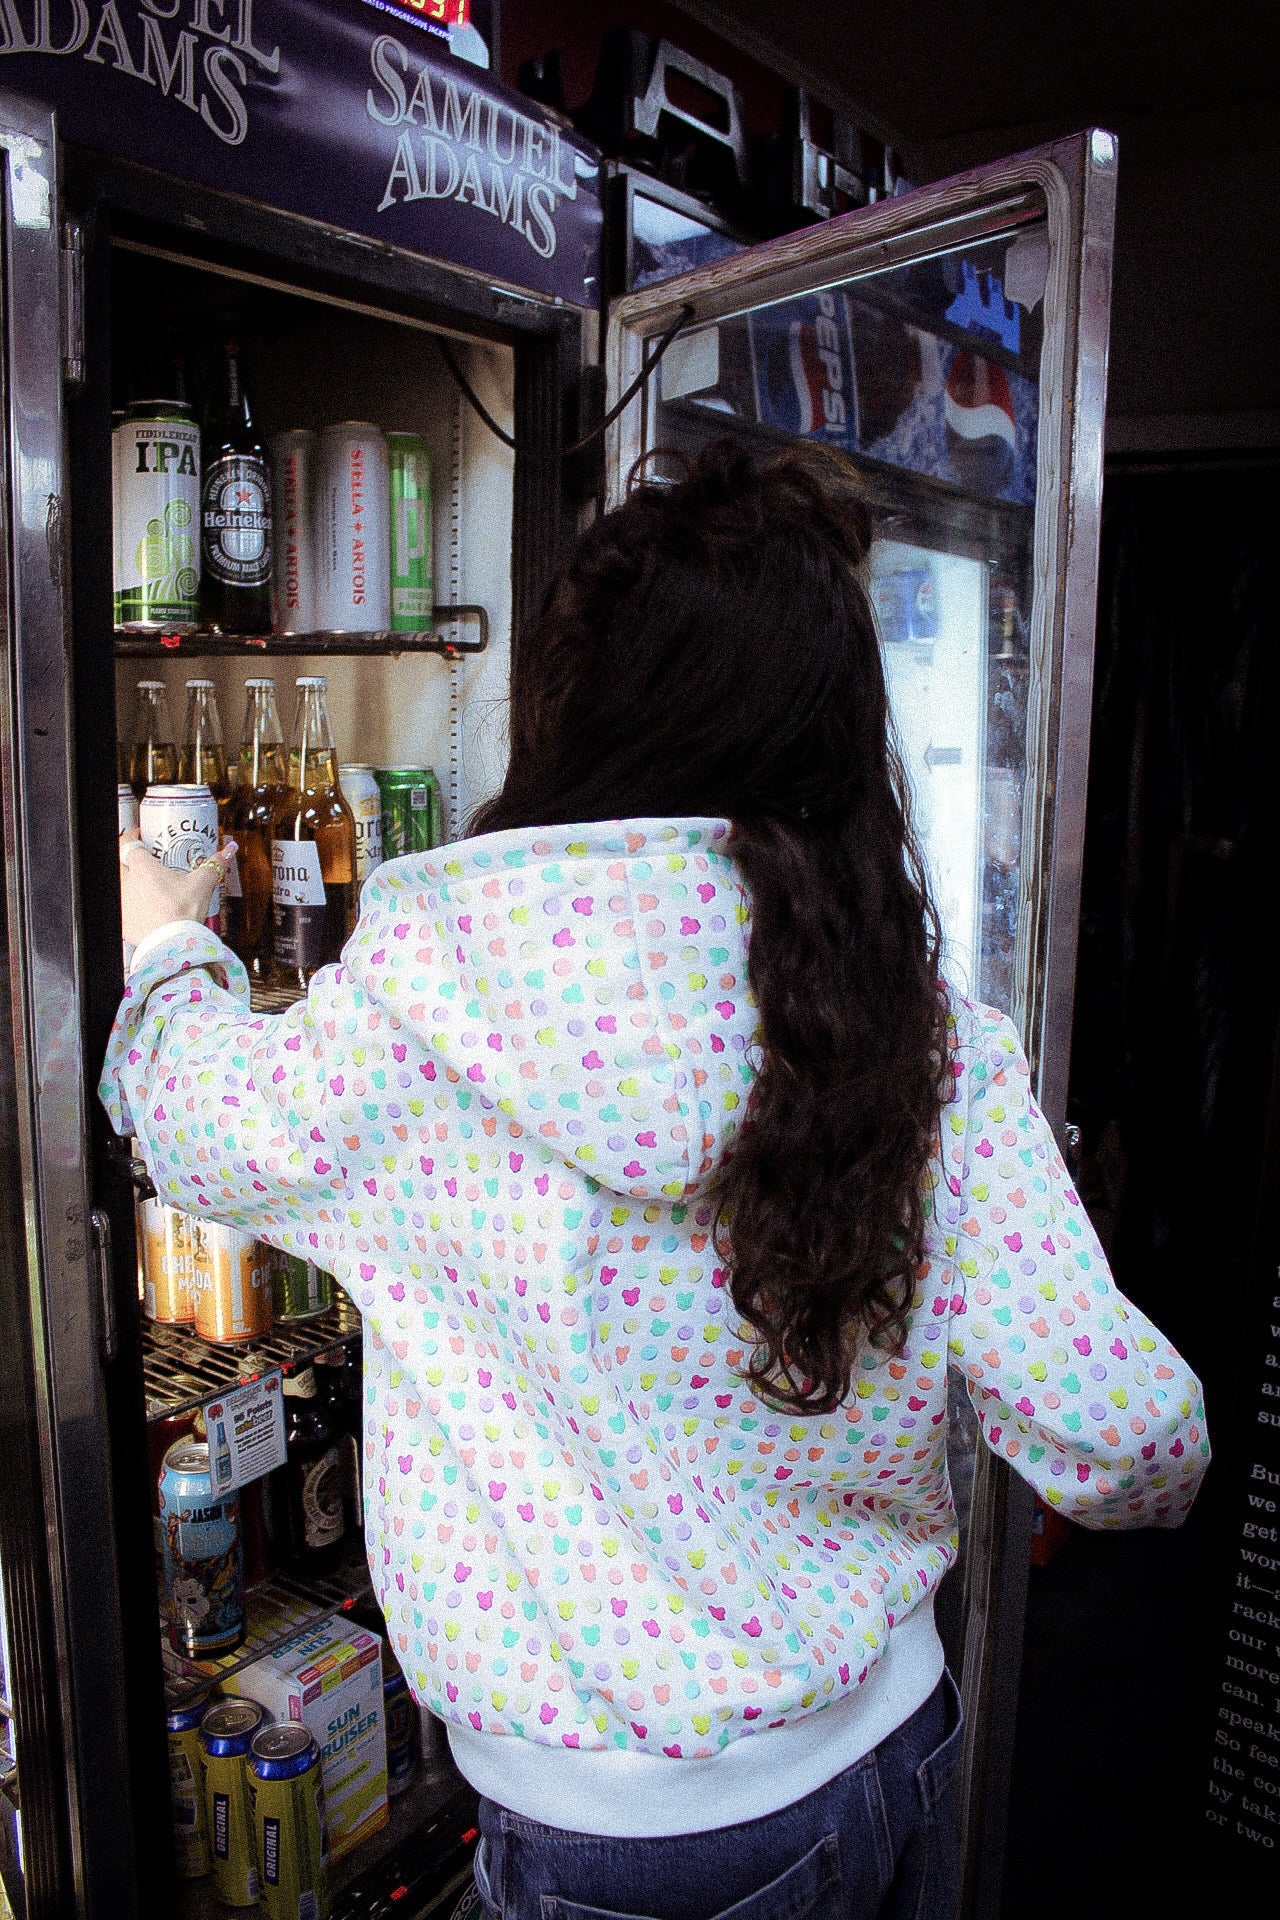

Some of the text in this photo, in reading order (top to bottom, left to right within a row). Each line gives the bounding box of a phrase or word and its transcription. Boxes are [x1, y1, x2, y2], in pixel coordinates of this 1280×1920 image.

[366, 34, 577, 200] SAMUEL
[377, 128, 557, 259] ADAMS
[814, 290, 848, 434] PEPSI
[135, 441, 198, 477] IPA
[283, 457, 298, 521] STELLA
[351, 448, 365, 516] STELLA
[285, 544, 300, 609] ARTOIS
[351, 538, 366, 606] ARTOIS
[180, 820, 217, 844] CLAW
[1248, 1493, 1277, 1514] we
[1242, 1522, 1279, 1543] get
[1228, 1629, 1267, 1651] our
[1225, 1654, 1280, 1685] more
[1221, 1681, 1265, 1708] can.
[321, 1710, 379, 1760] RUISER
[327, 1703, 360, 1736] SUN
[1215, 1729, 1241, 1752] So
[1212, 1755, 1246, 1781] the
[1208, 1779, 1234, 1804] by
[217, 1800, 227, 1852] ORIGINAL
[1205, 1808, 1275, 1849] or two
[266, 1824, 278, 1879] ORIGINAL
